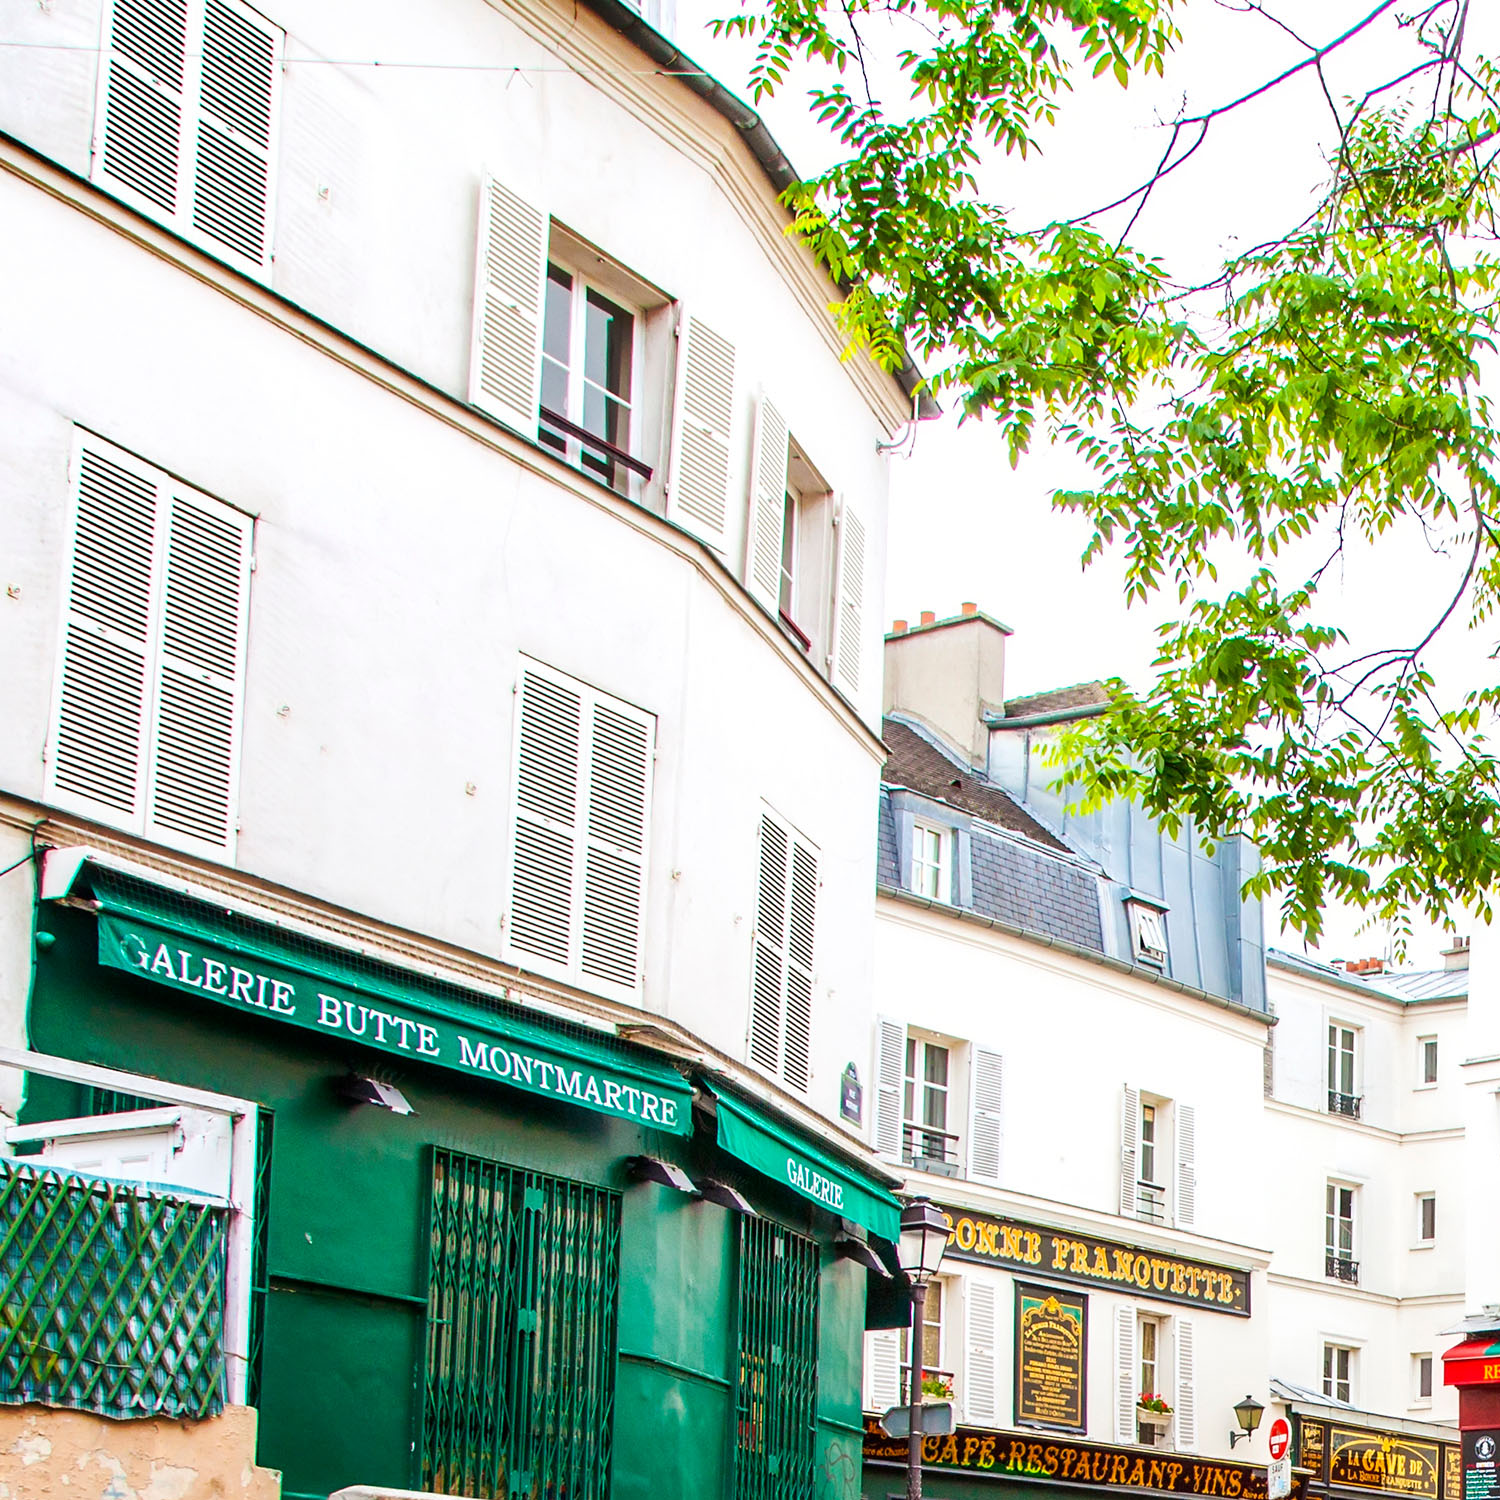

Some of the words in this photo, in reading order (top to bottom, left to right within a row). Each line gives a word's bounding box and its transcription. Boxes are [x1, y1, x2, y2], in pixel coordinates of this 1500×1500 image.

[119, 933, 296, 1016] GALERIE
[316, 993, 440, 1057] BUTTE
[457, 1035, 679, 1127] MONTMARTRE
[786, 1157, 844, 1210] GALERIE
[1051, 1236, 1234, 1304] FRANQUETTE
[921, 1434, 996, 1469] CAFÉ
[1005, 1440, 1184, 1490] RESTAURANT
[1192, 1464, 1243, 1497] VINS
[1347, 1449, 1360, 1467] LA
[1361, 1448, 1407, 1477] CAVE
[1409, 1459, 1423, 1476] DE
[1347, 1467, 1358, 1480] LA
[1359, 1469, 1380, 1484] BONNE
[1380, 1473, 1422, 1490] FRANQUETTE
